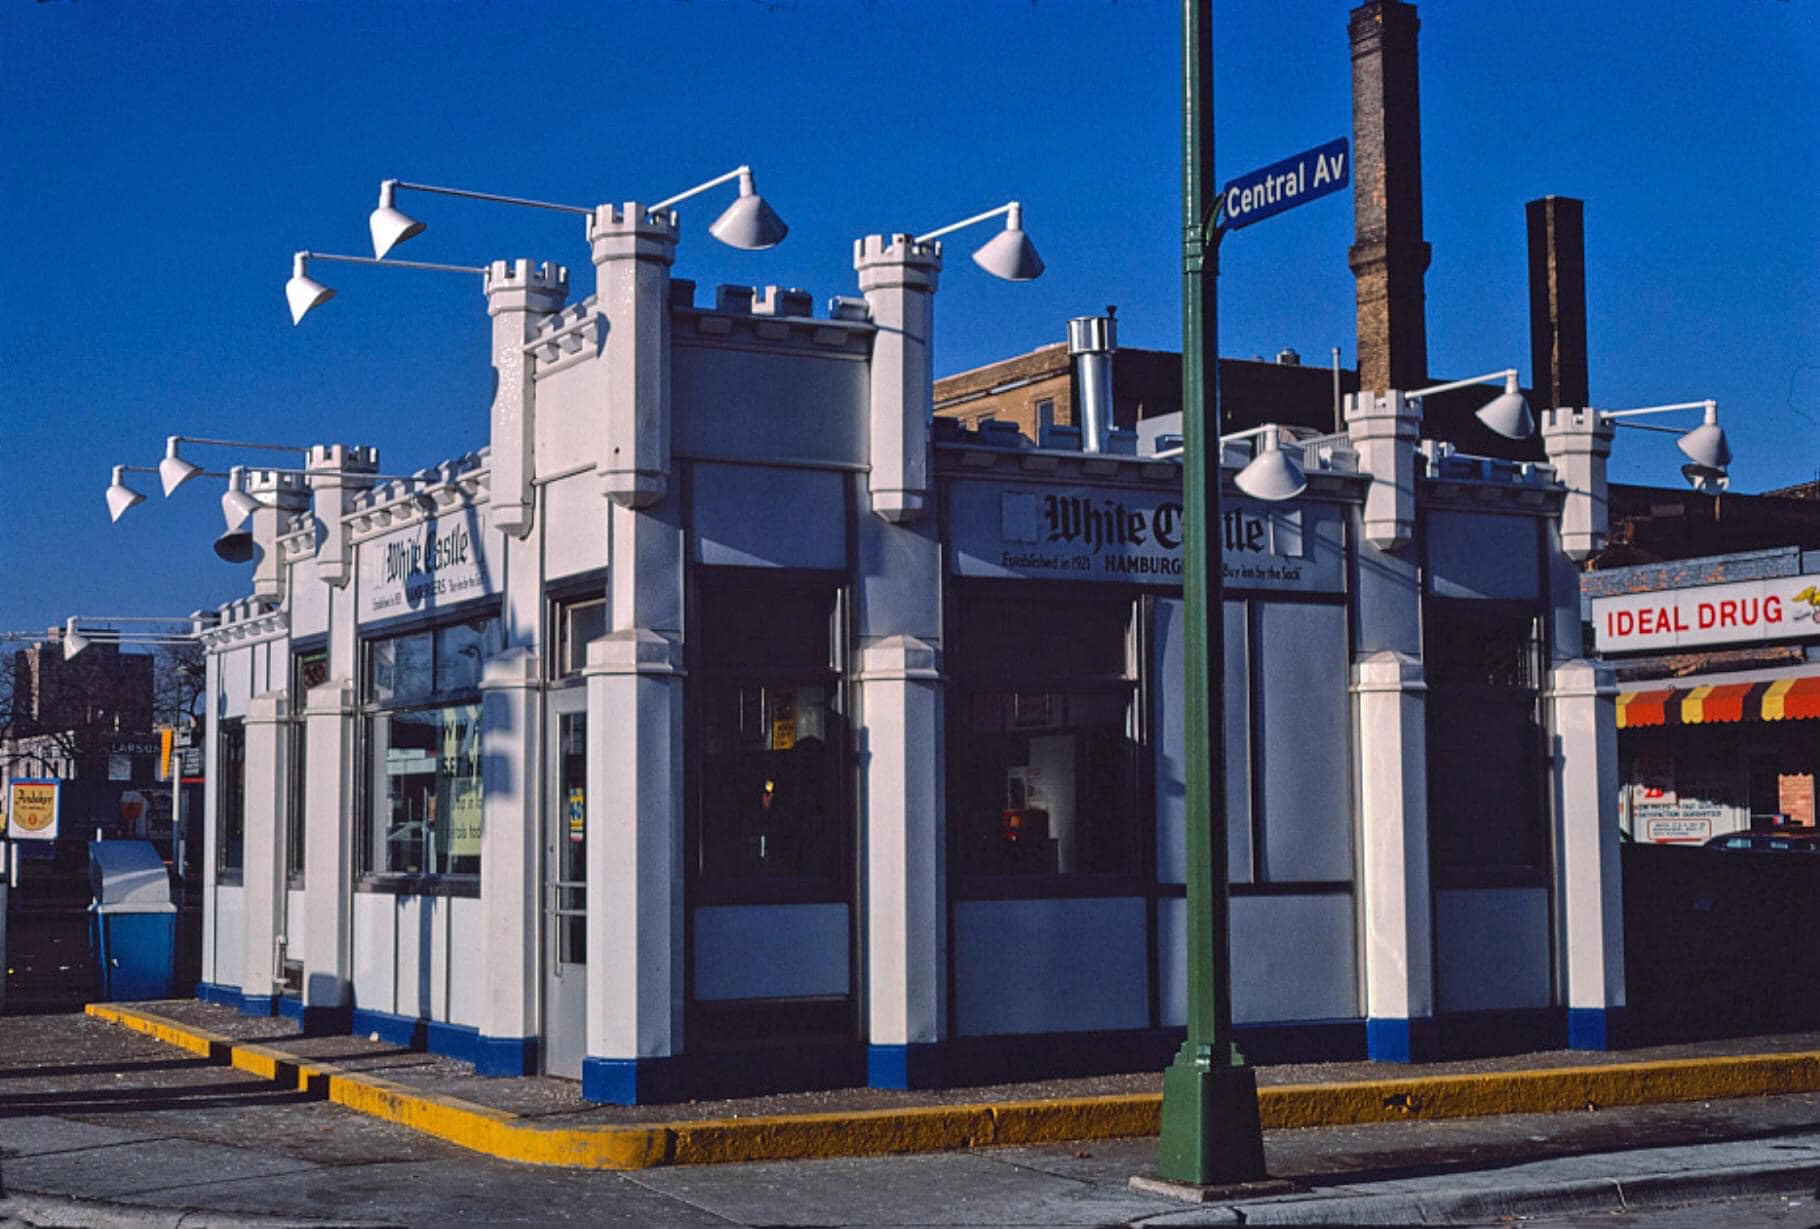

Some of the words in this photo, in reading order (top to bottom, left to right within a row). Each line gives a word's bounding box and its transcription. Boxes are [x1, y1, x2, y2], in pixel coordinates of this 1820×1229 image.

[1227, 161, 1305, 218] Central
[1313, 152, 1344, 188] Av
[1043, 494, 1147, 554] White
[1152, 500, 1265, 554] Ctle
[1104, 554, 1184, 575] HAMBURG
[1607, 605, 1690, 638] IDEAL
[1698, 595, 1783, 629] DRUG
